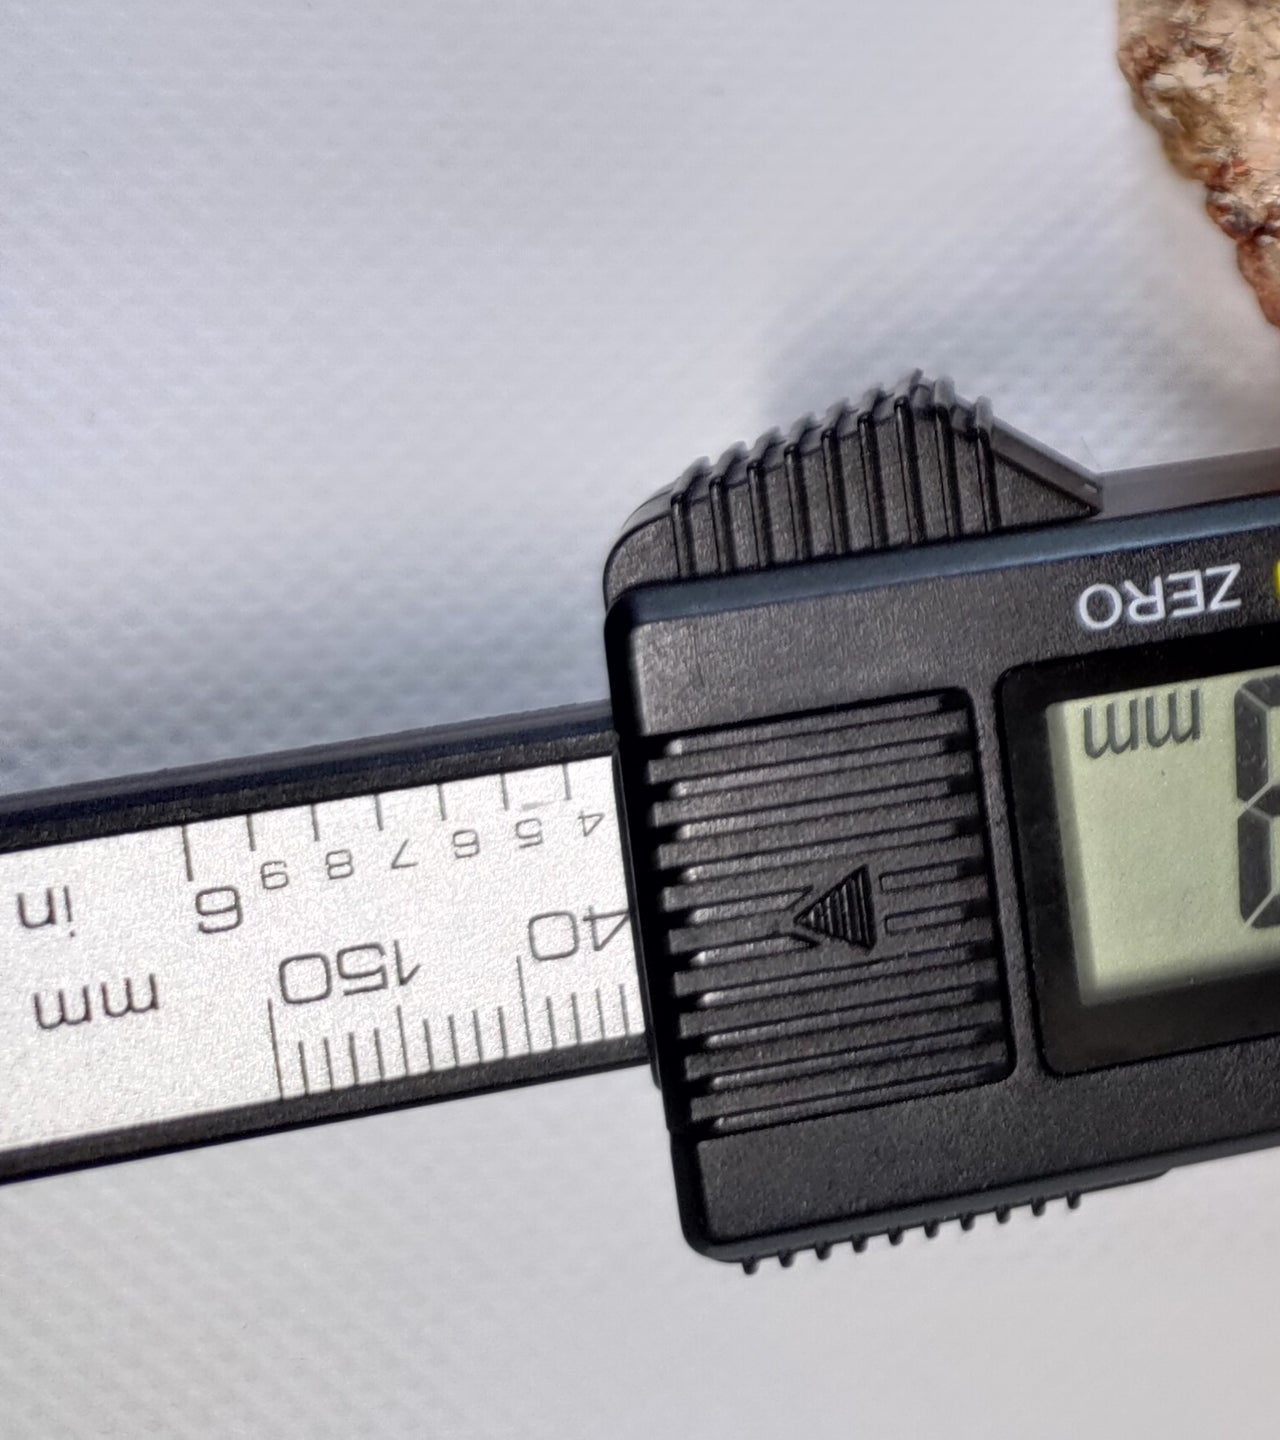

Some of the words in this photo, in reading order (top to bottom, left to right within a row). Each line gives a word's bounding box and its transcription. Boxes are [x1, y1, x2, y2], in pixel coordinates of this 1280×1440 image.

[1079, 563, 1242, 629] ZERO
[1084, 691, 1200, 758] mm
[515, 819, 543, 847] 5
[577, 810, 604, 836] 4
[390, 839, 418, 869] 7
[452, 829, 479, 857] 6
[260, 860, 288, 889] 9
[325, 850, 353, 879] 8
[16, 885, 74, 937] in
[195, 885, 243, 933] 6
[278, 940, 422, 1004] 150
[33, 973, 159, 1029] mm
